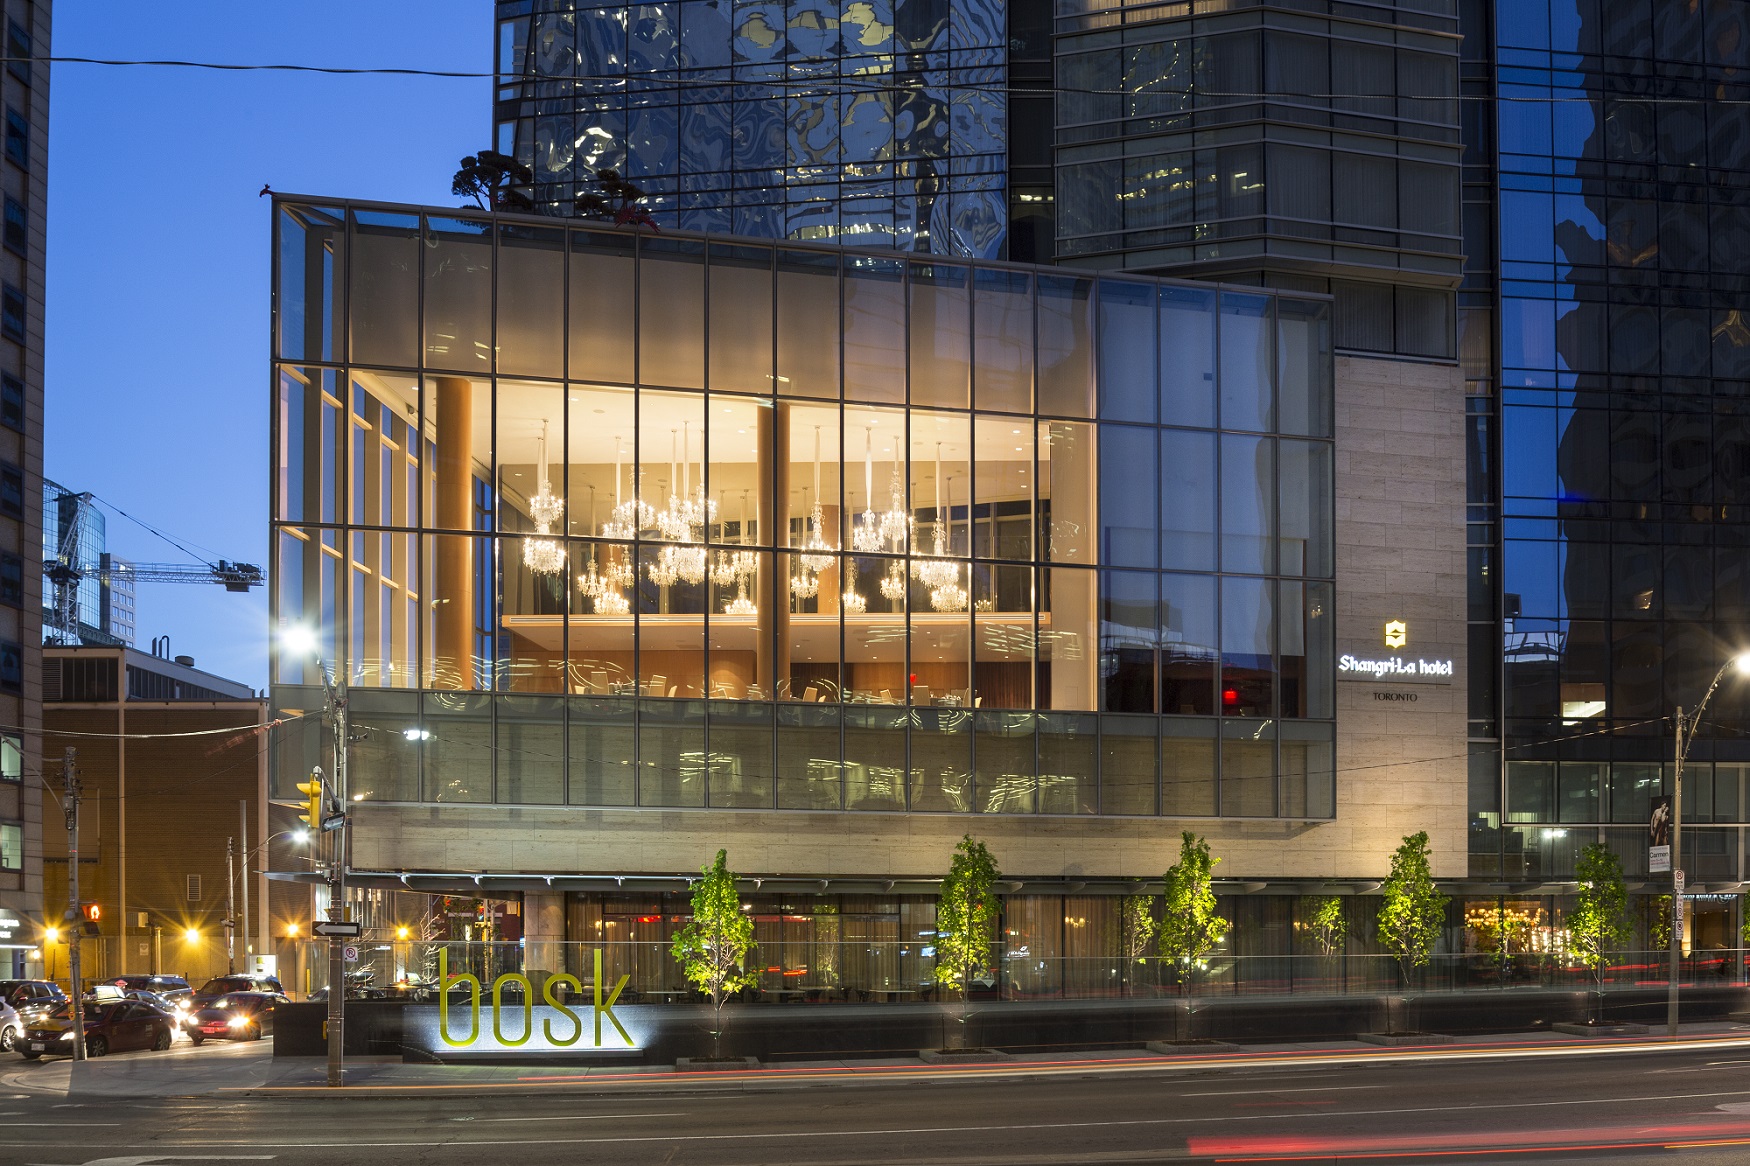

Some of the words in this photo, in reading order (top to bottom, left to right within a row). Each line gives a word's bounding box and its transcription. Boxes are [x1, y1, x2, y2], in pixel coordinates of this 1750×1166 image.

[1419, 658, 1453, 675] hotel
[1373, 692, 1418, 702] TORONTO
[439, 948, 635, 1047] bosk
